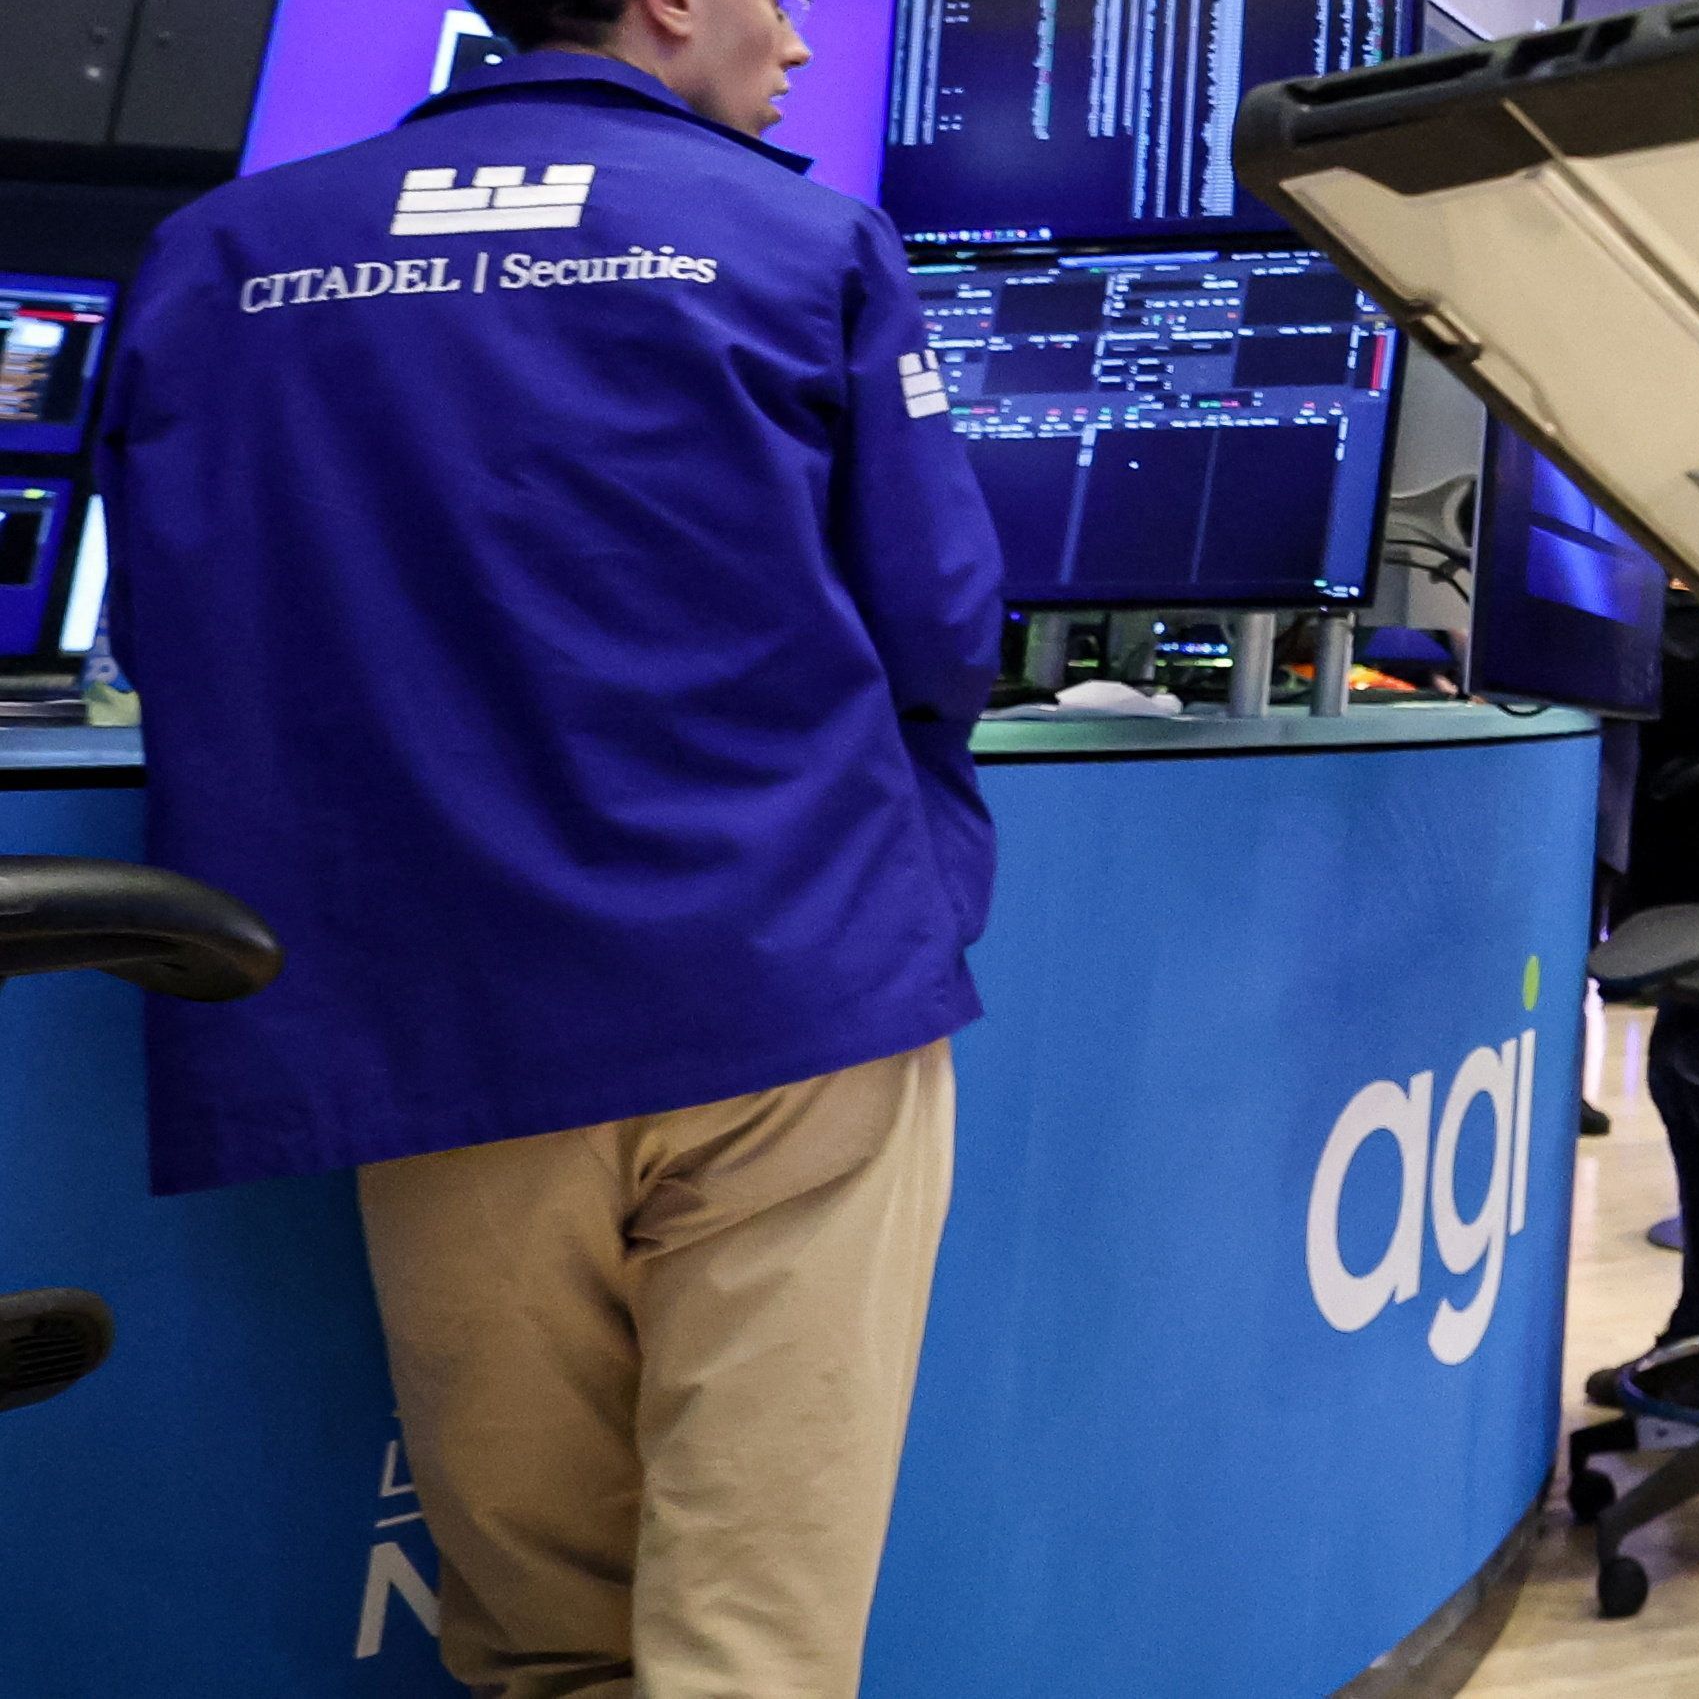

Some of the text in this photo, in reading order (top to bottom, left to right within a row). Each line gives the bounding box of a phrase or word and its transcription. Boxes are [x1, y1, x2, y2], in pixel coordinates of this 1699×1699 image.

[239, 246, 718, 314] CITADEL Securities
[1305, 954, 1540, 1367] agi
